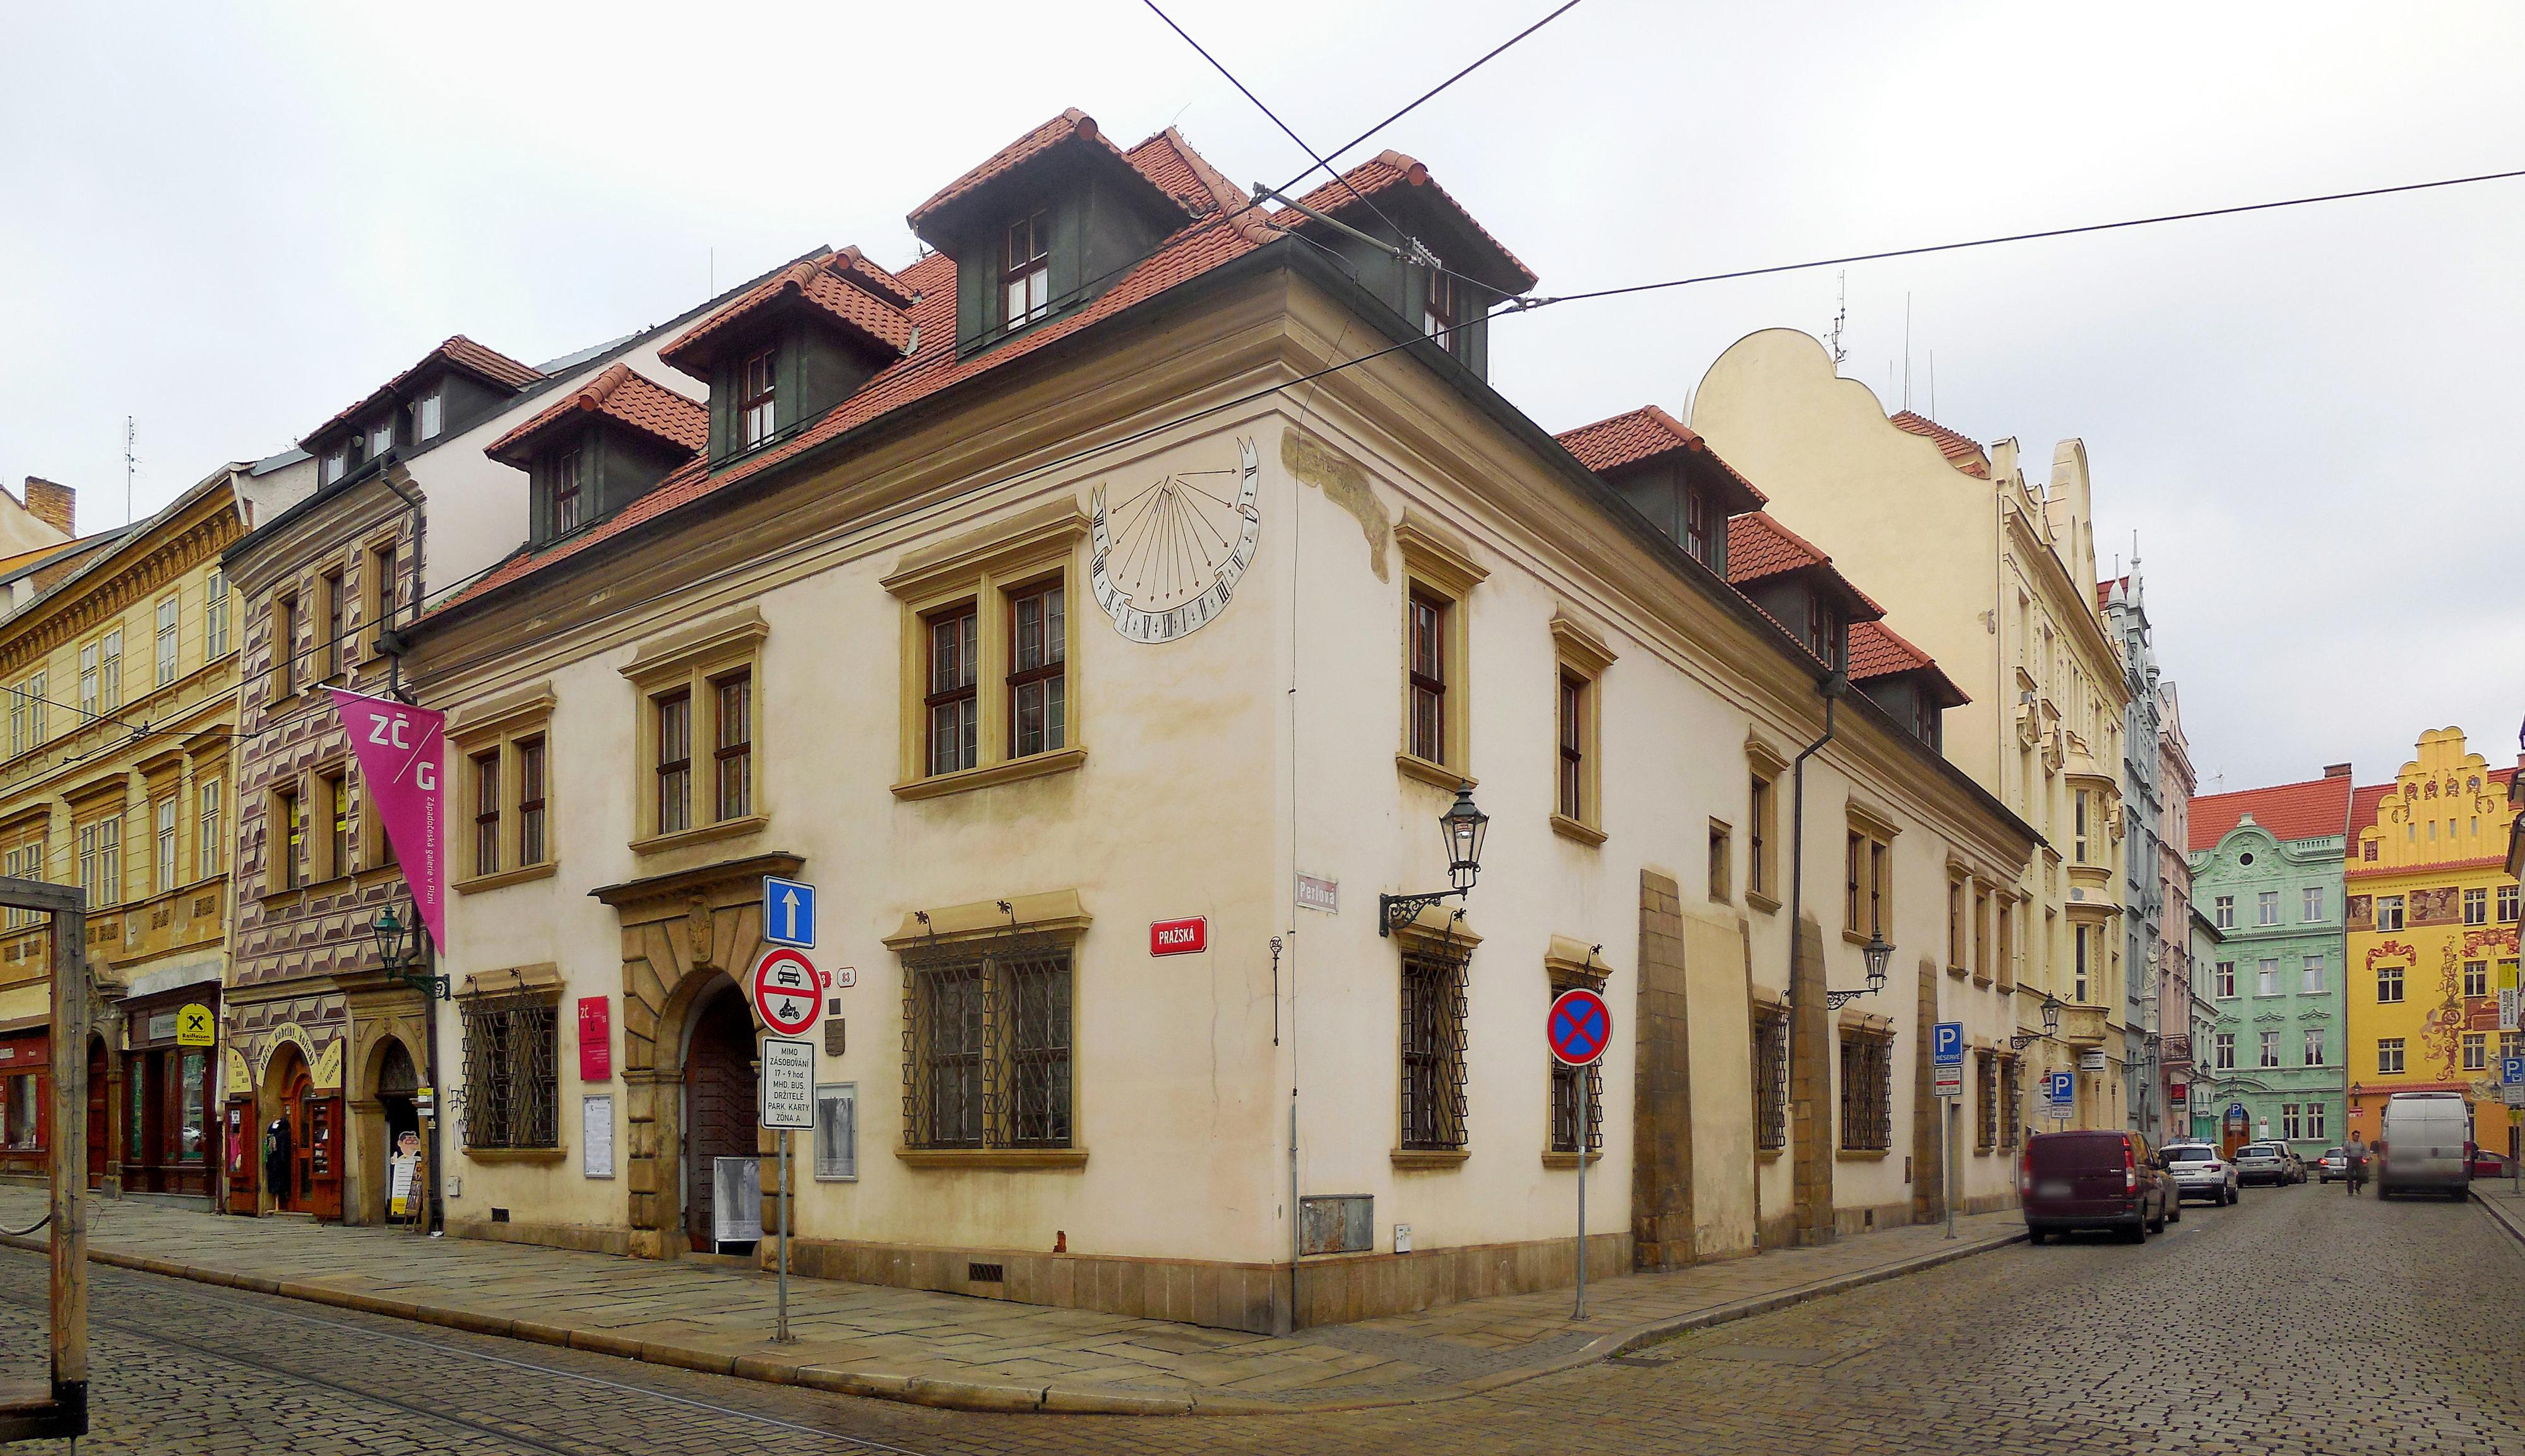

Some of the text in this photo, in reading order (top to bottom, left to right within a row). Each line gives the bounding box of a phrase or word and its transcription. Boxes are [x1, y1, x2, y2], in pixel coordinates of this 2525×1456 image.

[1216, 580, 1230, 604] III
[1182, 608, 1187, 632] I
[1198, 597, 1207, 620] II
[1141, 615, 1151, 639] XI
[1162, 613, 1172, 637] XII
[369, 712, 409, 750] ZČ
[417, 761, 435, 790] G
[425, 796, 434, 848] Západočeská
[425, 850, 434, 875] galerie
[1300, 882, 1334, 904] Perlová
[1159, 925, 1194, 945] PRAŽSKÁ
[842, 973, 850, 983] 83
[1939, 1028, 1956, 1053] P
[770, 1056, 809, 1067] ZÁSOBOVÁNÍ
[2507, 1061, 2519, 1077] P
[774, 1091, 804, 1100] DRŽITELÉ
[2056, 1076, 2069, 1094] P
[776, 1112, 793, 1122] ZÓNA
[2232, 1104, 2240, 1114] P
